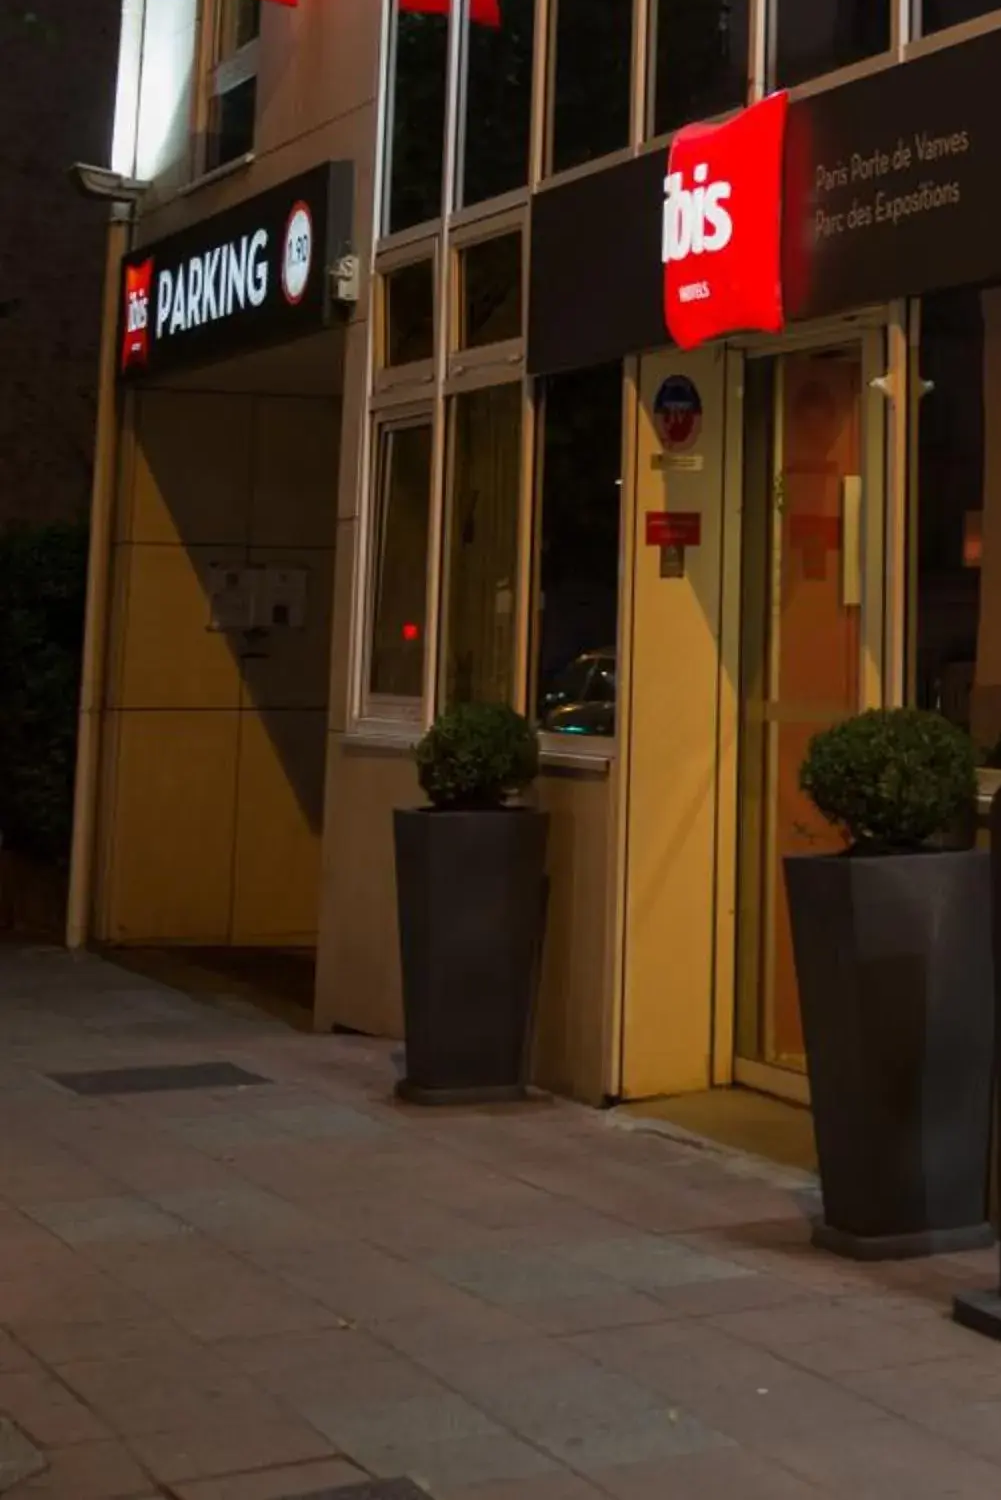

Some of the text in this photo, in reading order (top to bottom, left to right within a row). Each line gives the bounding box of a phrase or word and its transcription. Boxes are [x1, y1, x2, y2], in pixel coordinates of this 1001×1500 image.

[815, 130, 970, 193] Paris Porte de Vanves
[661, 162, 733, 263] ibis
[814, 180, 961, 242] Parc des Expositions
[156, 228, 269, 339] PARKING
